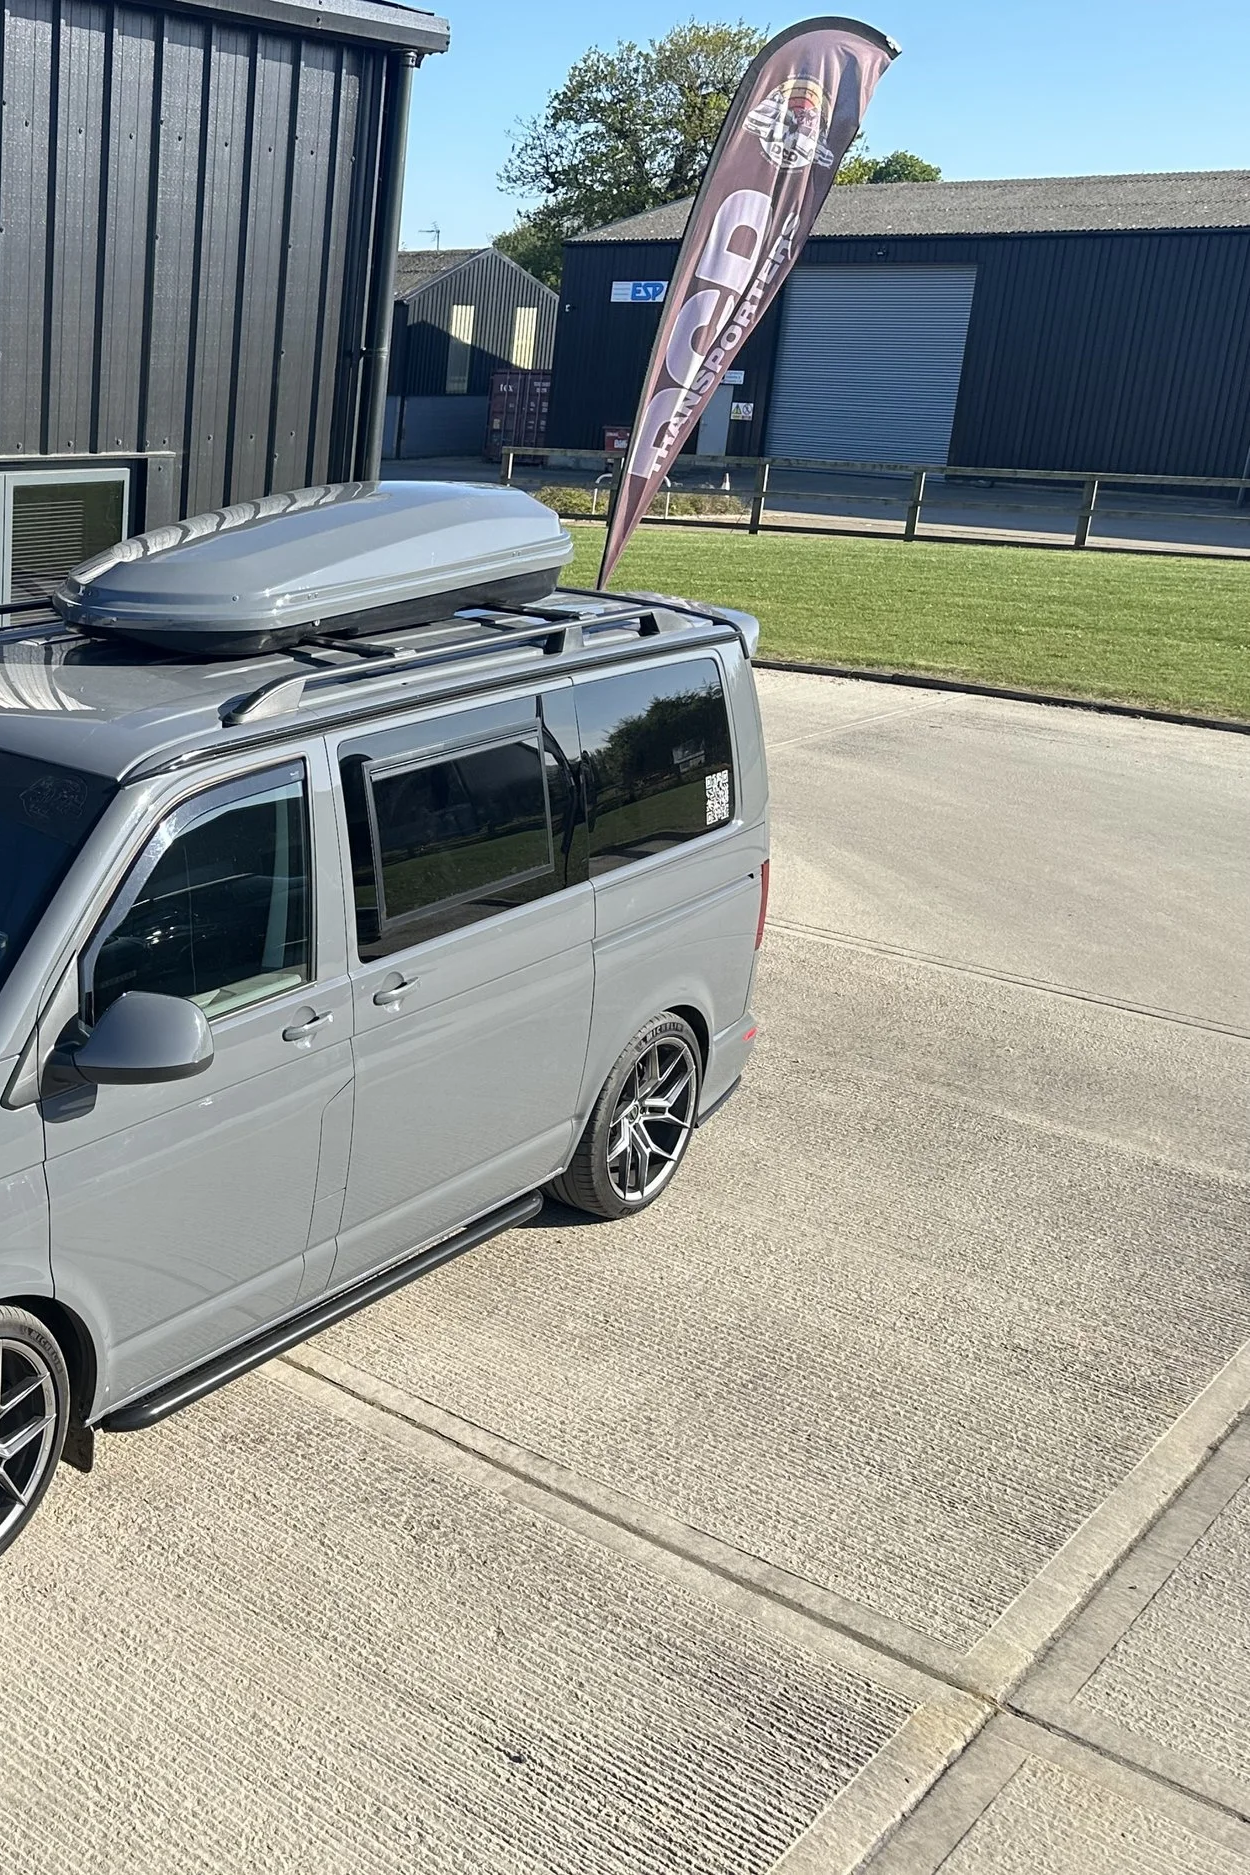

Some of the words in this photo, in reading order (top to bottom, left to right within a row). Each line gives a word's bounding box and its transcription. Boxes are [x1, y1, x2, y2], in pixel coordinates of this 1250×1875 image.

[626, 189, 773, 479] DCD
[631, 282, 664, 301] ESP
[650, 211, 801, 474] TRANSPORTERS
